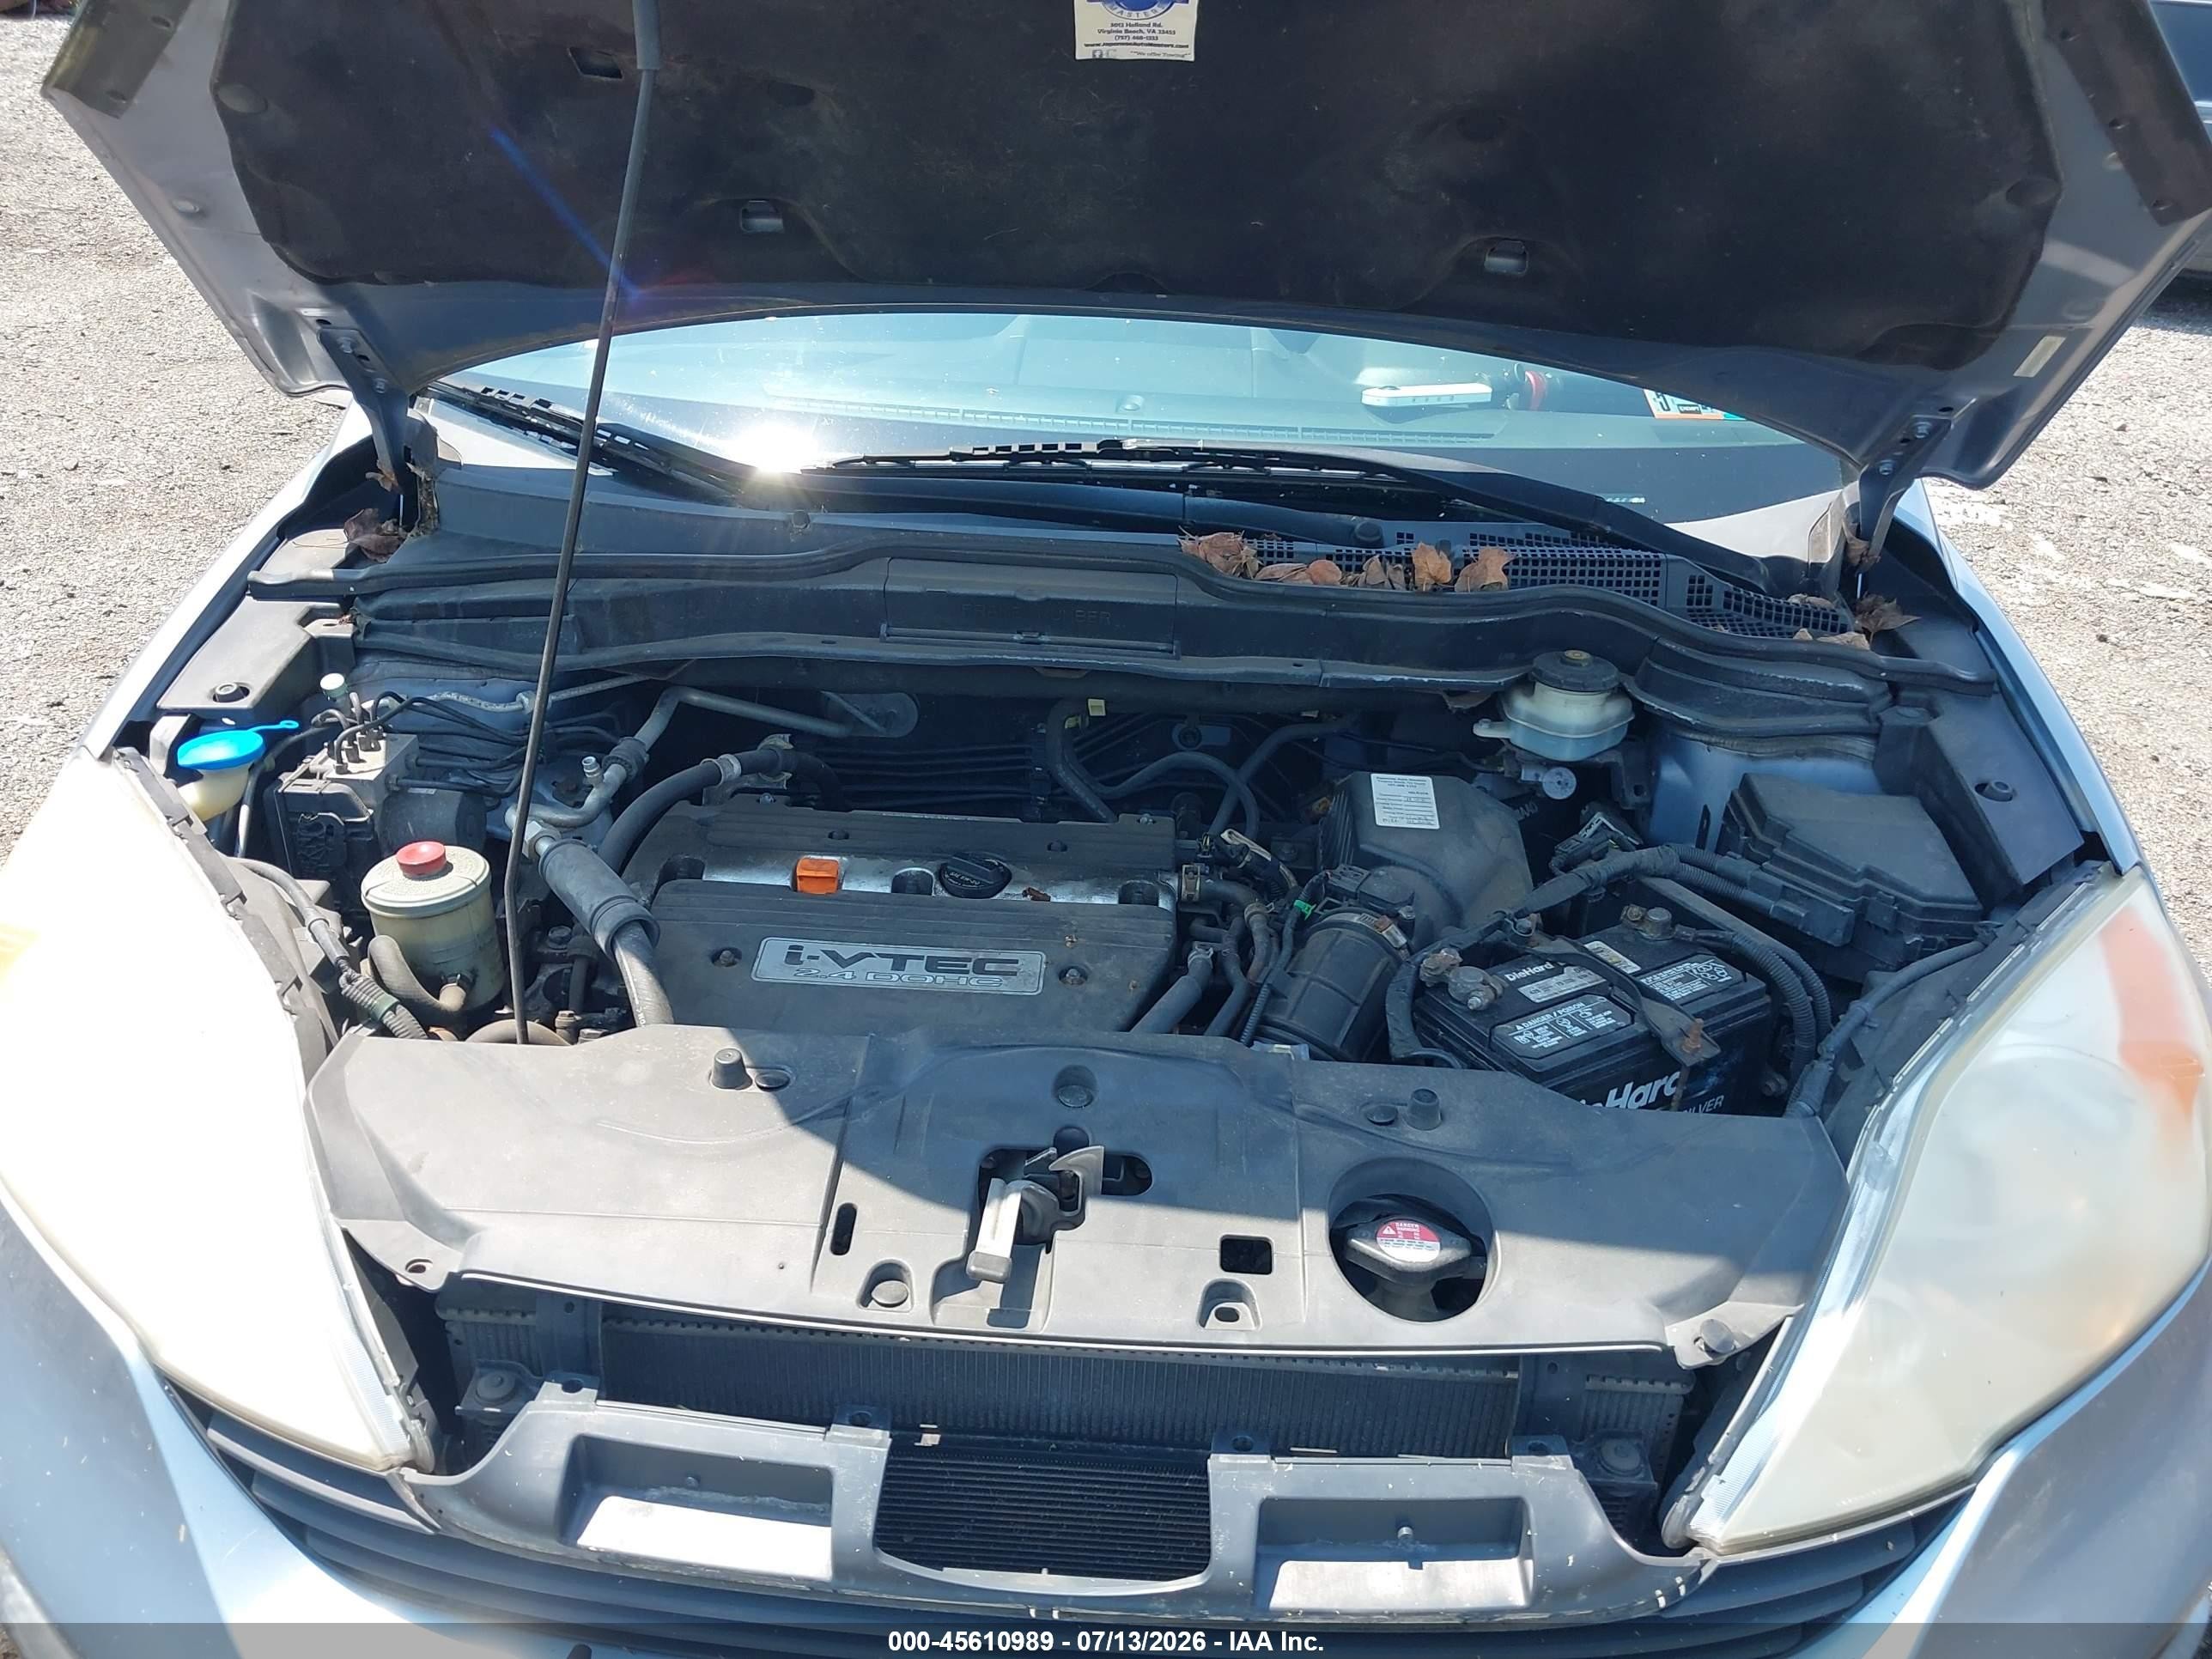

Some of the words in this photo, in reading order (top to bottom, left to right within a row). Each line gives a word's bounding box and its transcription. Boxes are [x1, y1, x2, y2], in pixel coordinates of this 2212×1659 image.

[784, 945, 1019, 976] i-VTEC
[1504, 961, 1555, 981] DieHard
[793, 968, 857, 981] 2.4
[865, 971, 1005, 988] DOHC
[1521, 1013, 1553, 1029] DANGER
[1557, 1001, 1586, 1015] POISON
